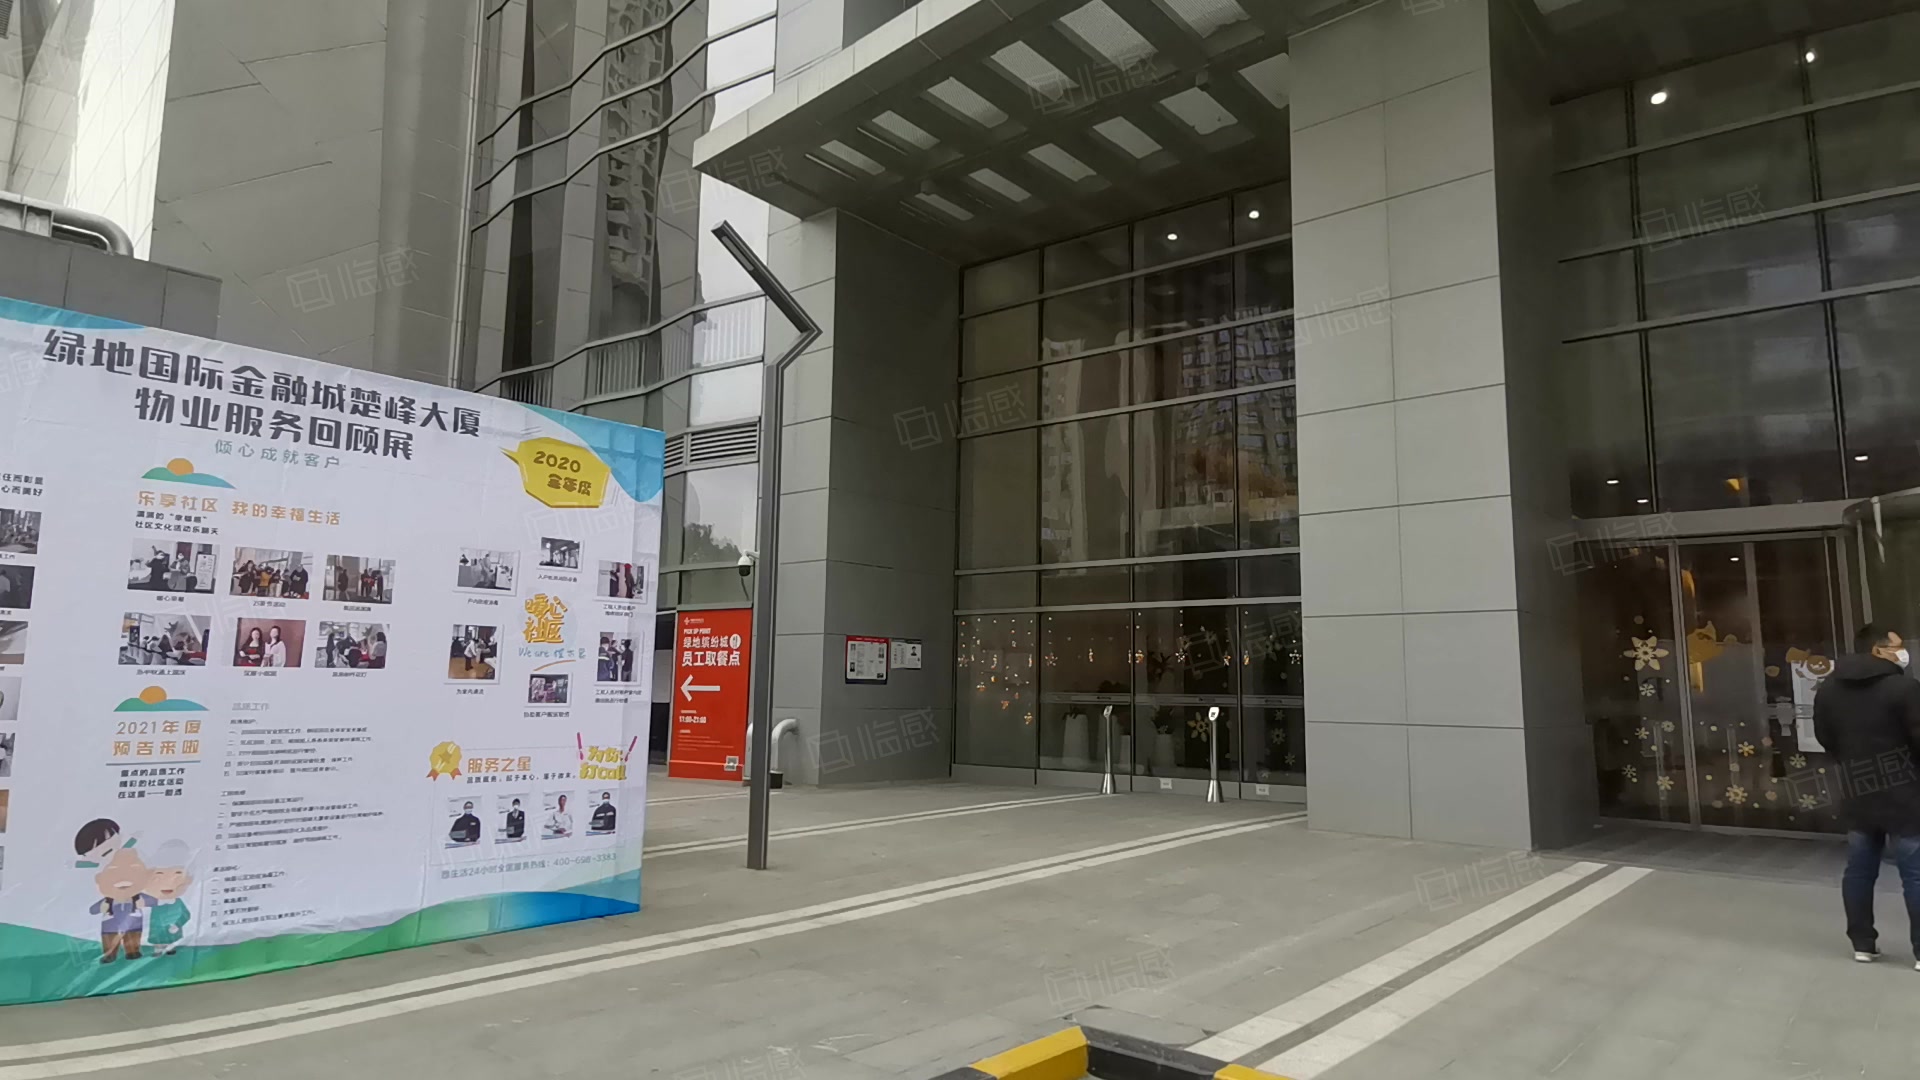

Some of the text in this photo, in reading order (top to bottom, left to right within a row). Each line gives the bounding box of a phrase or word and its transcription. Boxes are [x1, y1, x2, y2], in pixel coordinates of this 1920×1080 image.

[43, 328, 480, 437] 绿地国际金融城楚峰大厦
[135, 387, 414, 460] 物业服务回顾展
[215, 439, 340, 469] 倾心成就客户
[533, 451, 581, 473] 2020
[138, 491, 340, 525] 乐享社区 我的幸福生活
[681, 650, 741, 667] 员工取餐点
[116, 719, 202, 735] 2021年度
[113, 739, 200, 756] 预告来啦
[467, 756, 532, 773] 服务之星
